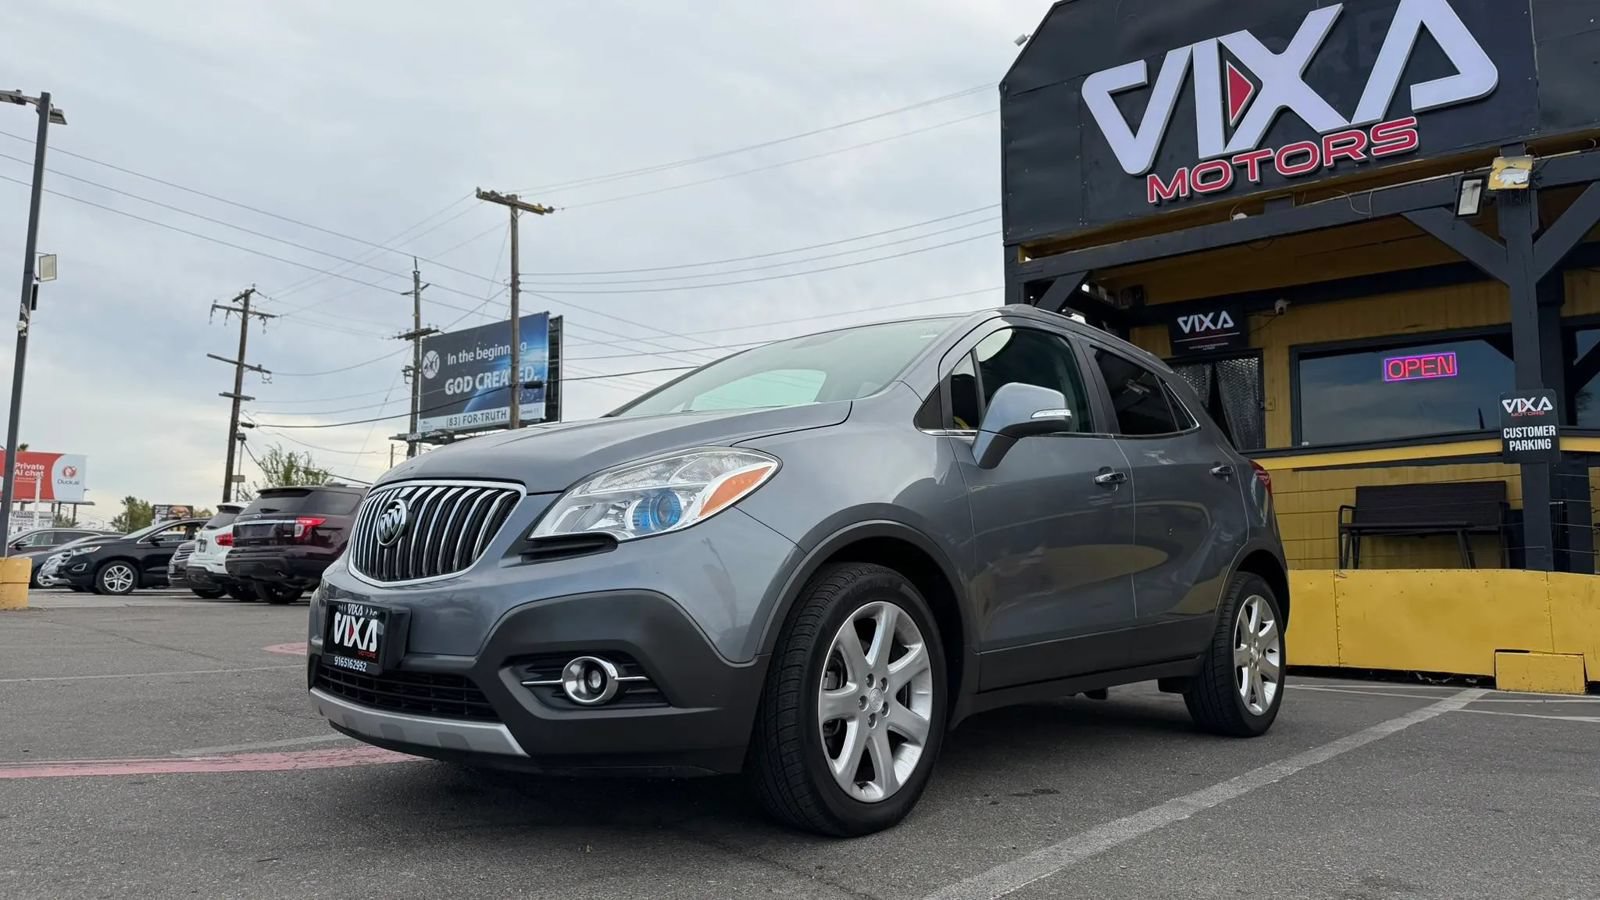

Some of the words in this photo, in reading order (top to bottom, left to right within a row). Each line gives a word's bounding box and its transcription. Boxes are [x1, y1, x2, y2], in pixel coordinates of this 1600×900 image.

[1081, 0, 1498, 176] VIXA
[1146, 116, 1419, 204] MOTORS
[1177, 310, 1235, 334] VIXA
[447, 353, 457, 366] In
[459, 349, 475, 363] the
[476, 342, 528, 361] beginng
[1387, 355, 1454, 378] OPEN
[445, 375, 473, 395] GOD
[1501, 396, 1554, 414] VIXA
[462, 409, 508, 425] FOR-TRUTH
[1503, 425, 1556, 439] CUSTOMER
[1508, 439, 1552, 452] PARKING
[15, 462, 45, 470] Private
[347, 603, 364, 616] VIXA
[334, 611, 378, 653] VIXA
